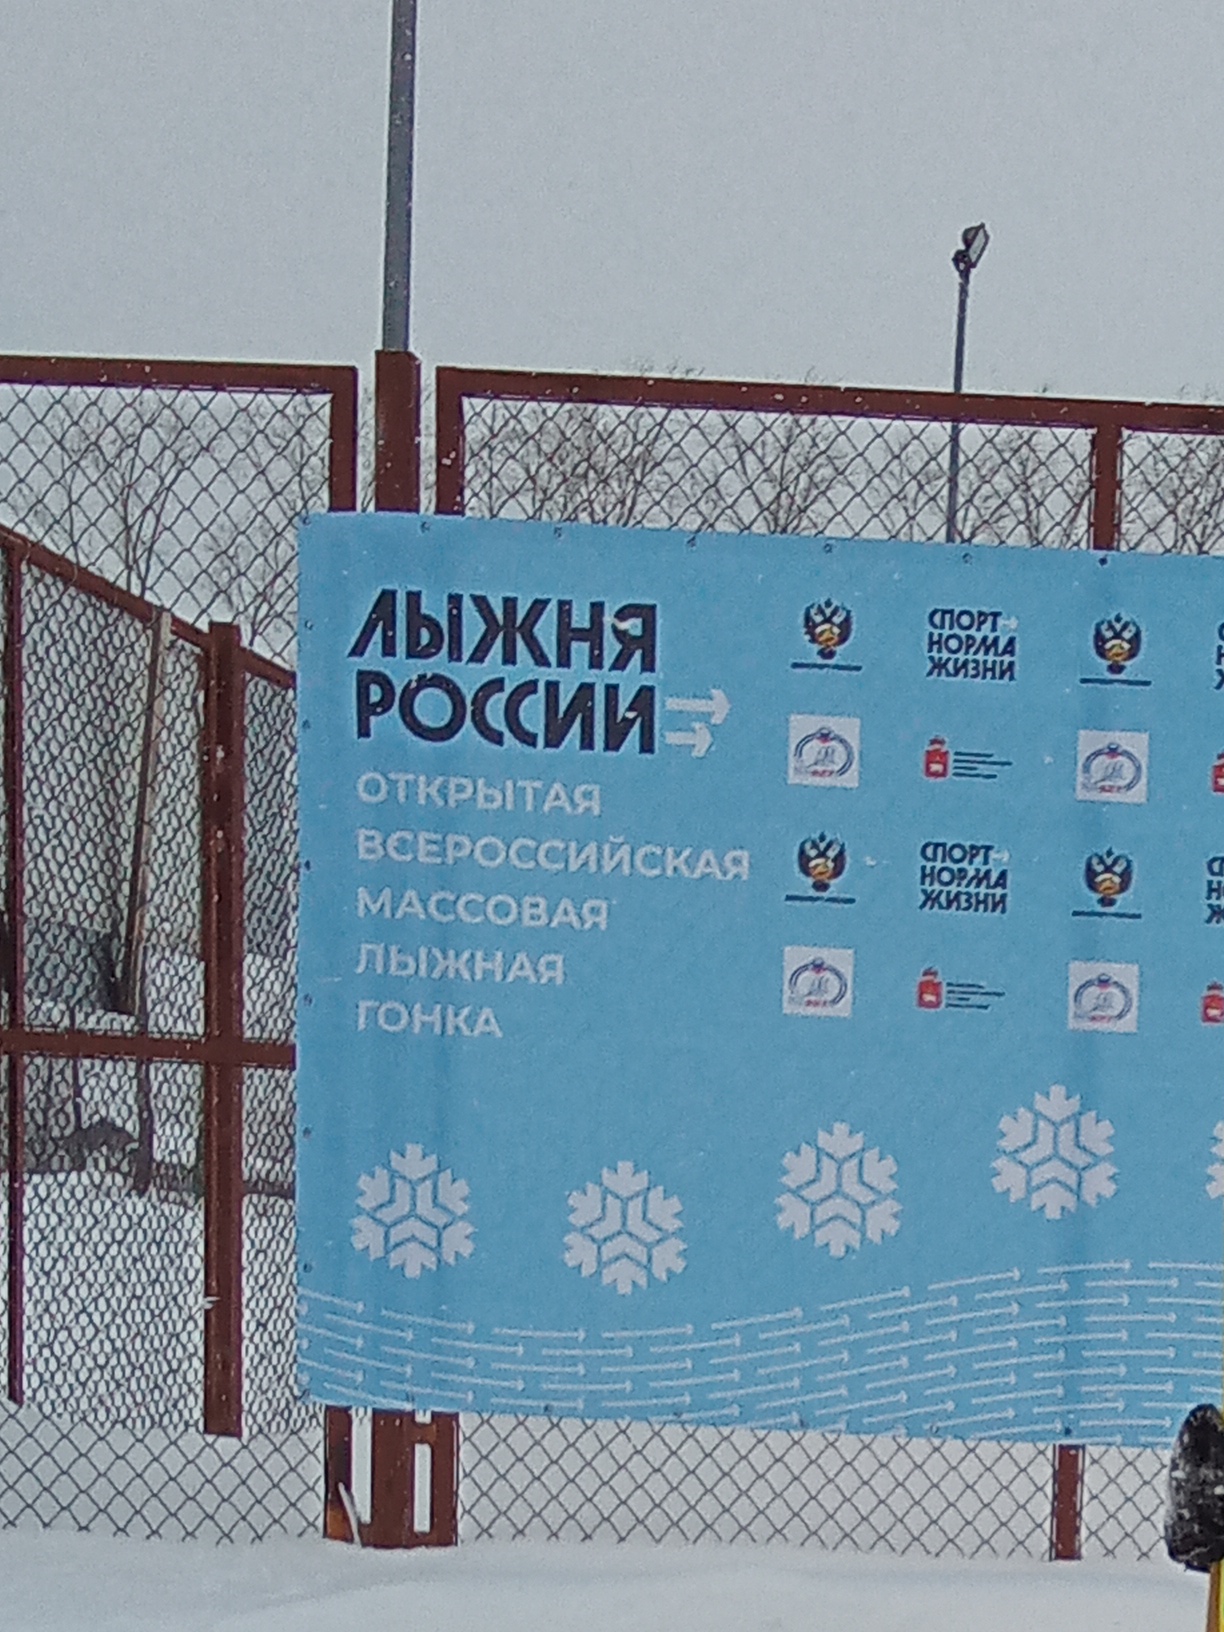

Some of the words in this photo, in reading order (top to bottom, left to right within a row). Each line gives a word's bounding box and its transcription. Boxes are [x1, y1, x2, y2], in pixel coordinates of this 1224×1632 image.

[347, 588, 658, 674] ЛЫЖНЯ
[927, 607, 1003, 634] СПОРТ
[926, 631, 1017, 658] НОРМА
[925, 655, 1017, 682] ЖИЗНИ
[356, 668, 656, 755] РОССИИ
[356, 772, 602, 817] ОТКРЫТАЯ
[356, 828, 750, 881] ВСЕРОССИЙСКАЯ
[919, 840, 995, 866] СПОРТ
[919, 864, 1009, 891] НОРМА
[355, 886, 609, 931] МАССОВАЯ
[918, 888, 1008, 915] ЖИЗНИ
[355, 942, 566, 986] ЛЫЖНАЯ
[356, 999, 503, 1038] ГОНКА
